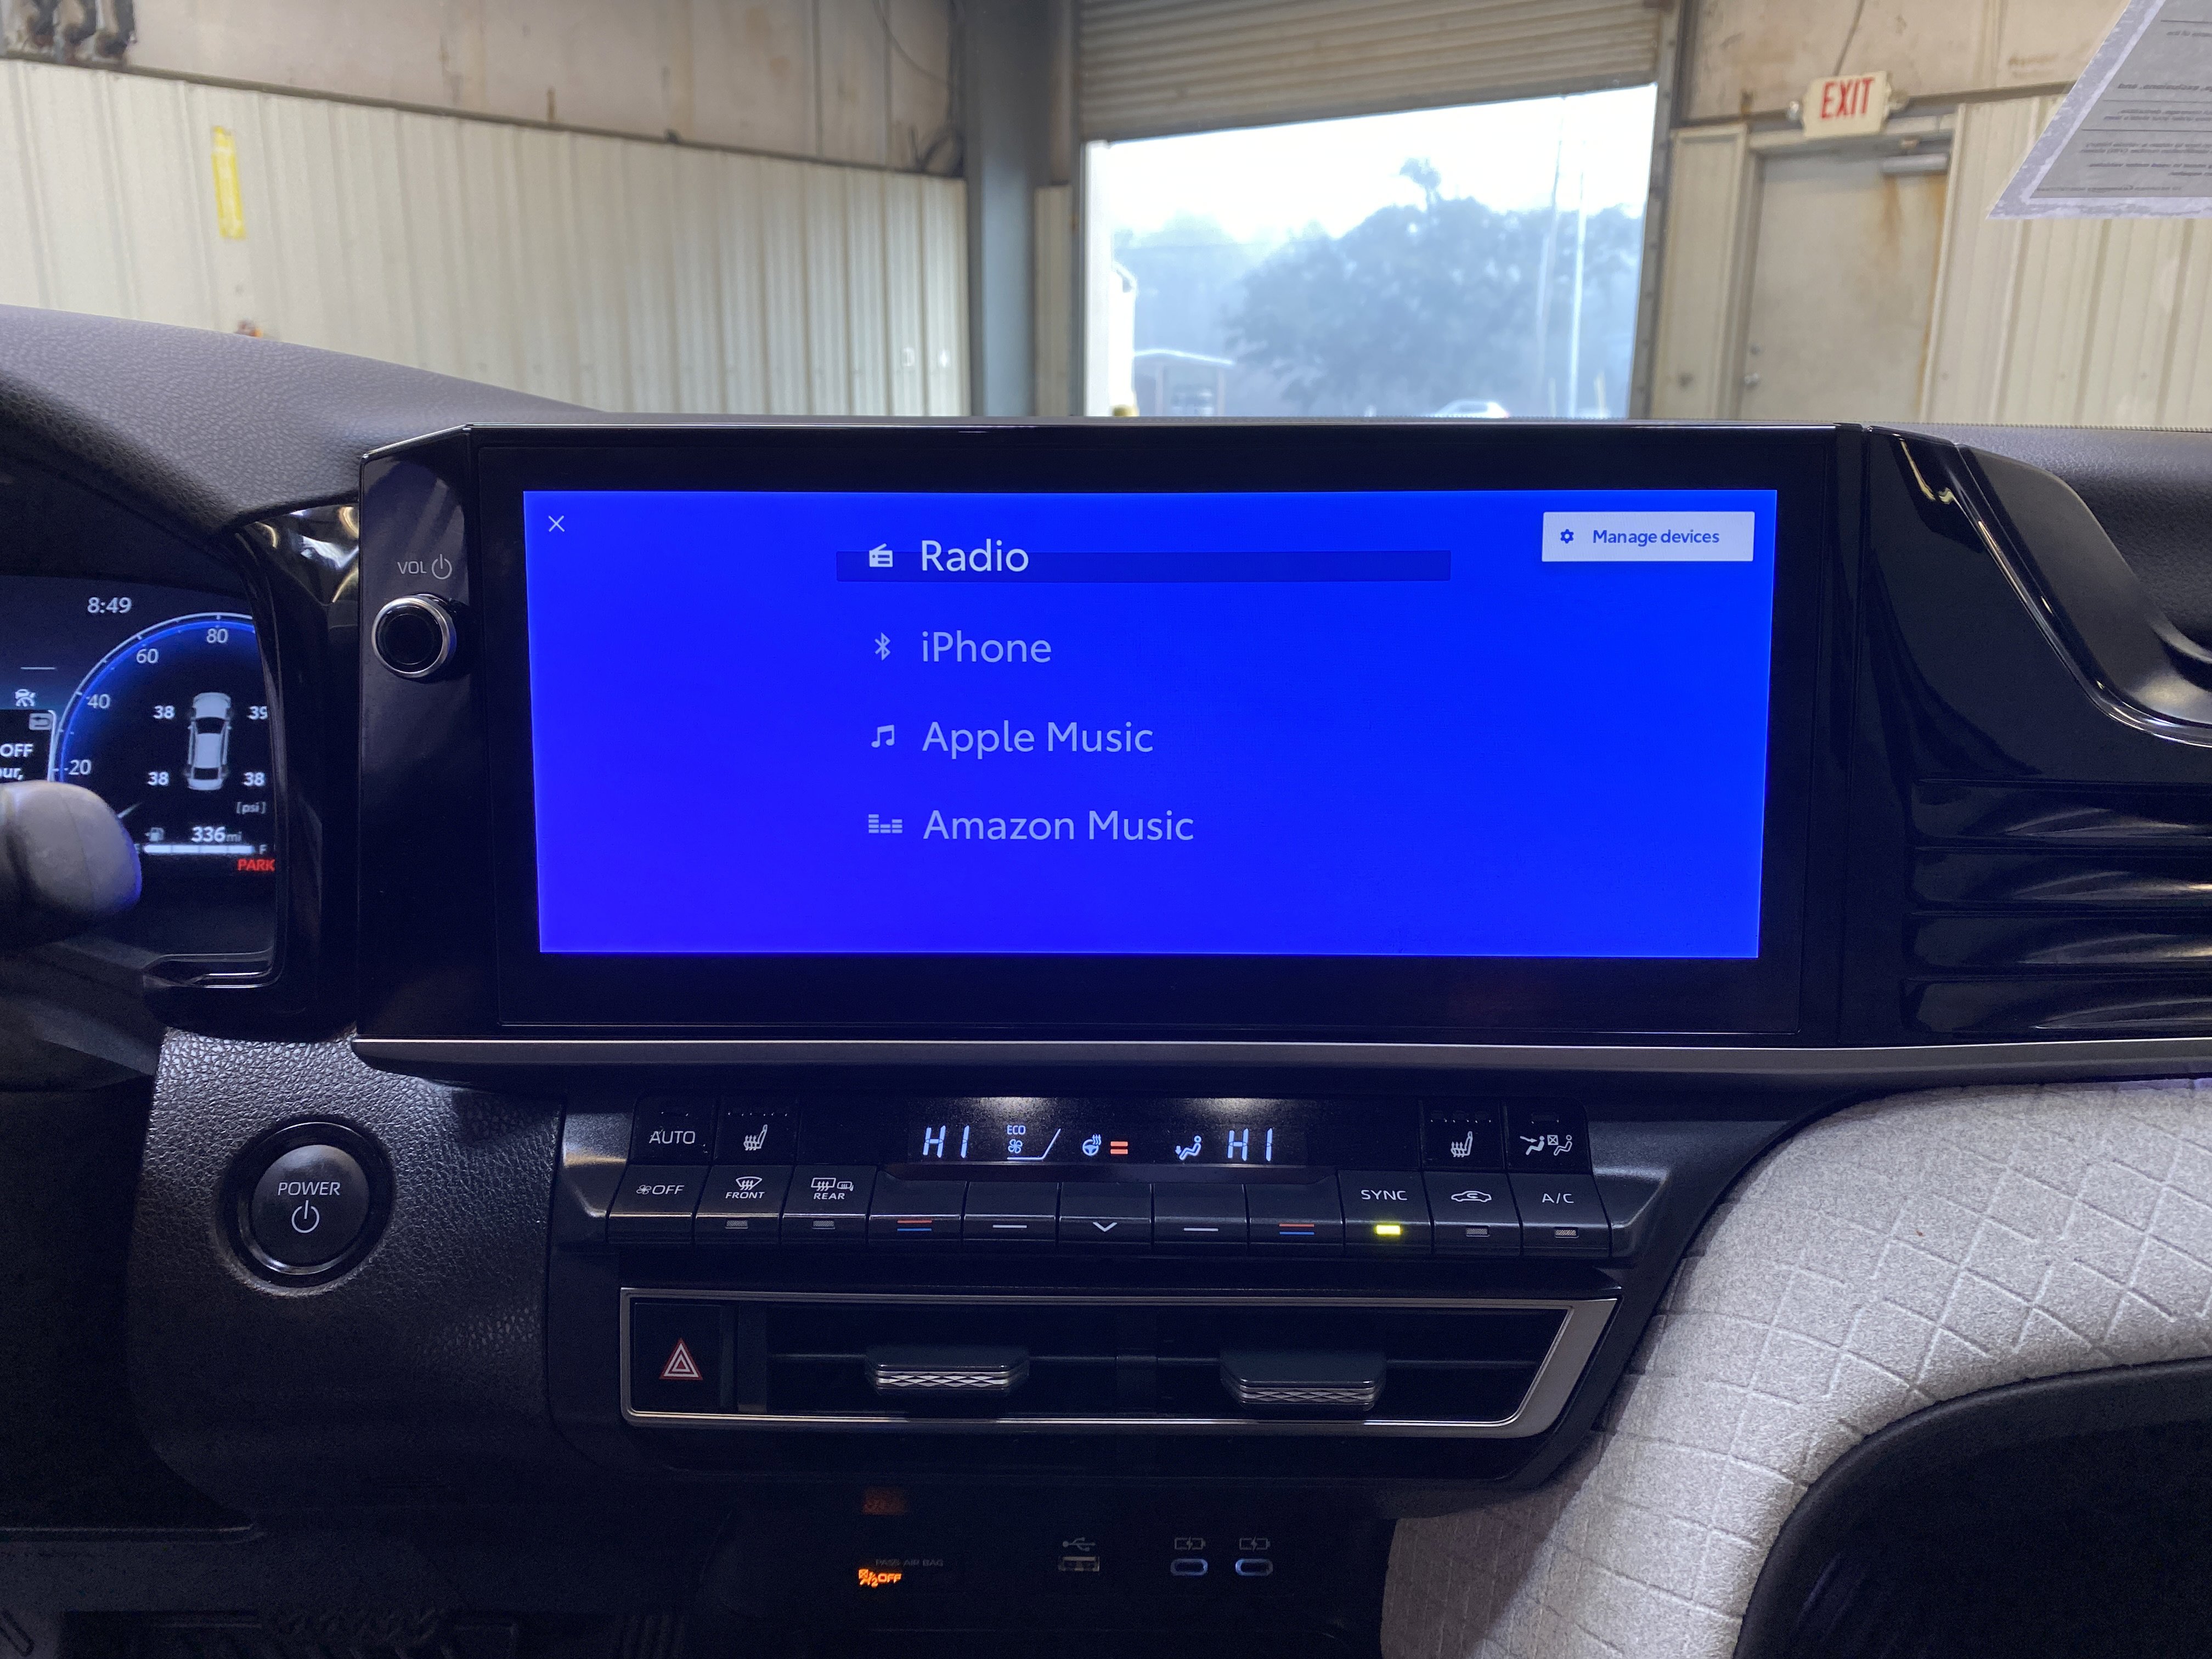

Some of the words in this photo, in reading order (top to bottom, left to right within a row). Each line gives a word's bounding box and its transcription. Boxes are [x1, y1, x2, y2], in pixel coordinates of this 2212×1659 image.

[1820, 76, 1876, 120] EXIT
[1592, 529, 1658, 547] Manage
[1660, 529, 1720, 544] devices
[921, 538, 1029, 572] Radio
[397, 560, 427, 575] VOL
[87, 596, 133, 614] 8:49
[206, 628, 229, 644] 80
[922, 629, 1052, 663] iPhone
[136, 648, 160, 664] 60
[87, 693, 111, 709] 40
[153, 705, 176, 720] 38
[922, 720, 1035, 760] Apple
[1047, 721, 1154, 753] Music
[0, 743, 34, 758] OFF
[0, 767, 24, 781] ur,
[69, 759, 93, 775] 20
[147, 771, 170, 786] 38
[243, 771, 266, 786] 38
[922, 809, 1075, 840] Amazon
[1088, 810, 1195, 841] Music
[237, 858, 275, 872] PARK
[649, 1130, 696, 1144] AUTO
[1006, 1125, 1026, 1135] ECO
[277, 1181, 341, 1196] POWER
[651, 1184, 685, 1195] OFF
[725, 1191, 765, 1200] FRONT
[813, 1192, 845, 1200] REAR
[1360, 1189, 1408, 1201] SYNC
[1542, 1192, 1575, 1205] A/C
[878, 1572, 902, 1583] OFF
